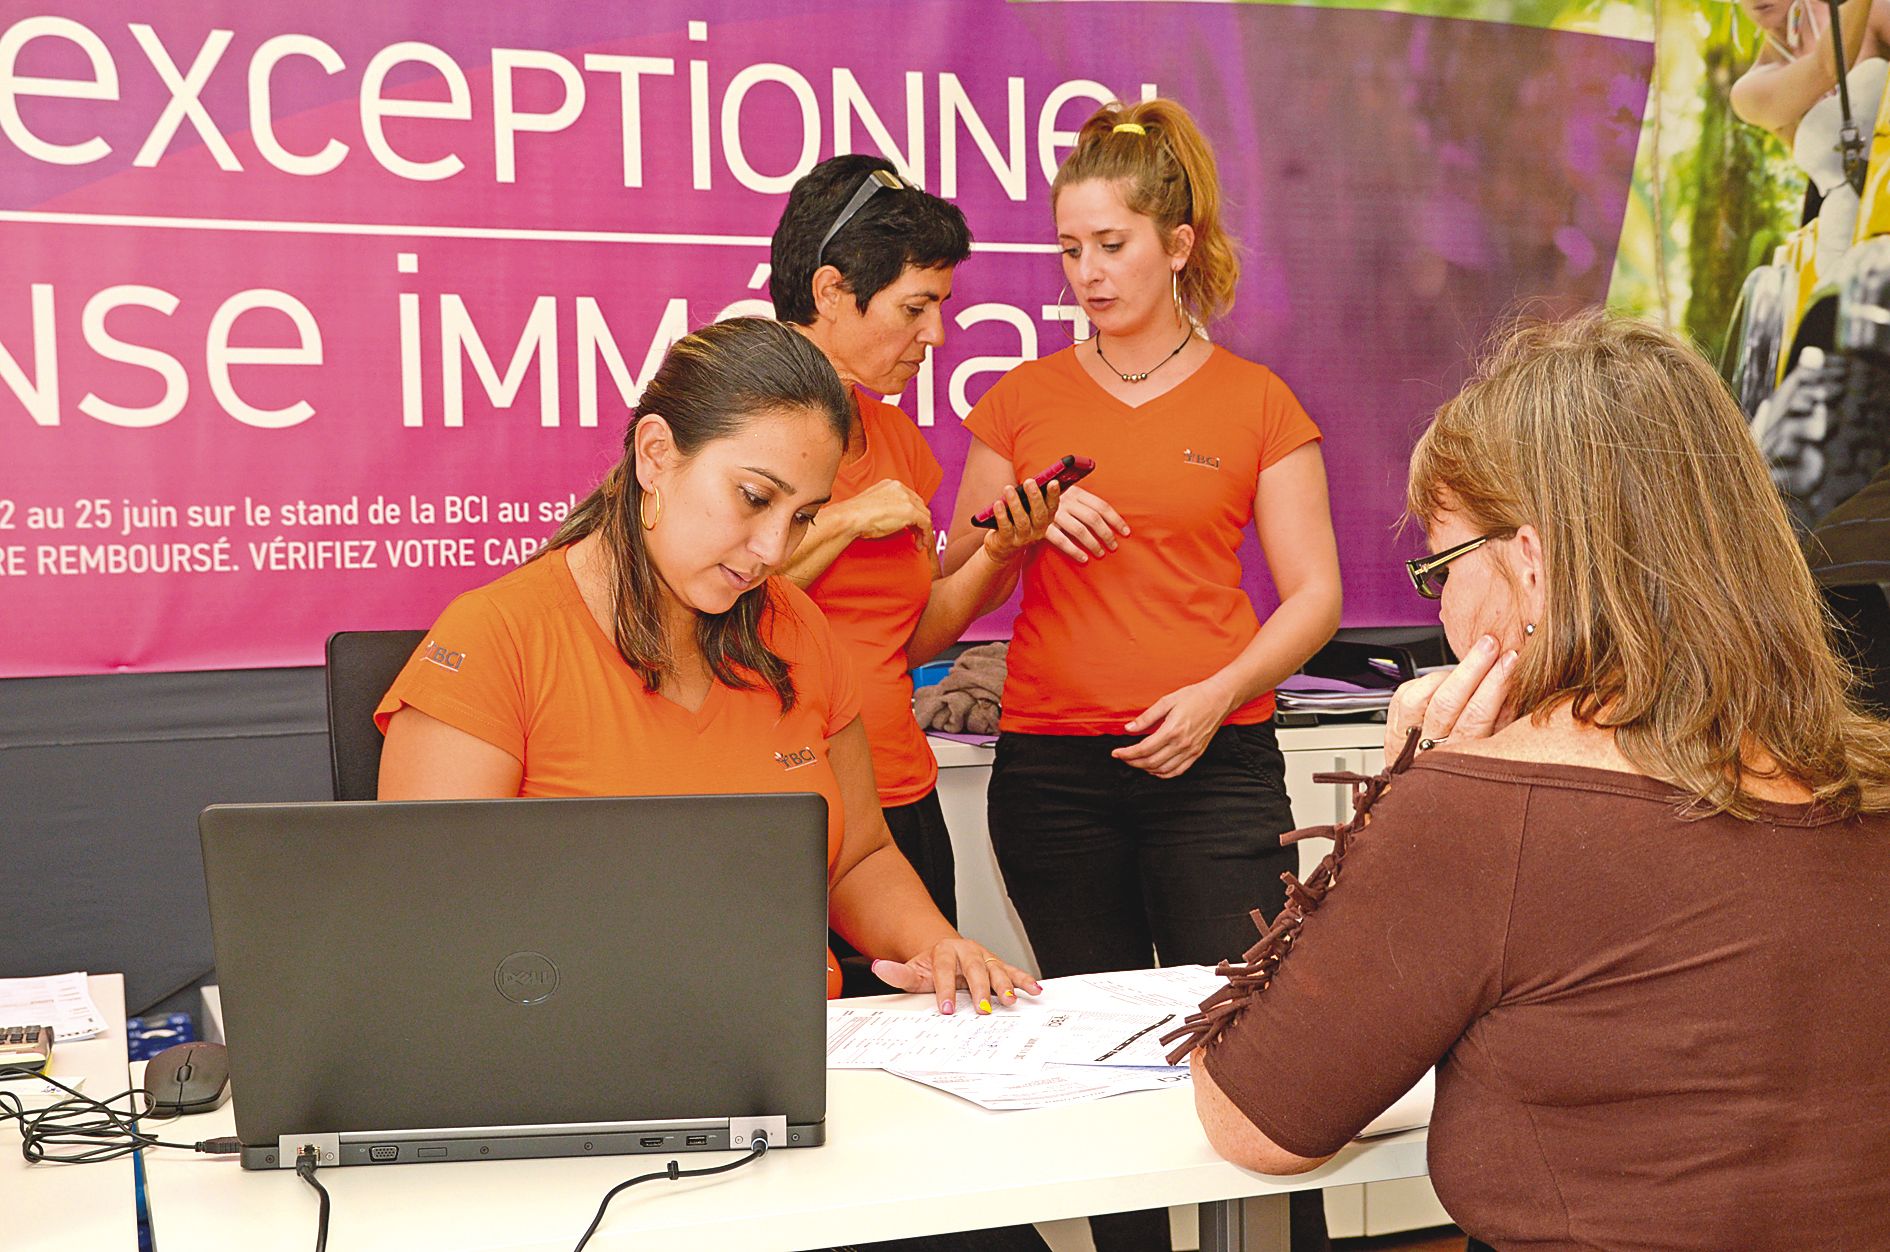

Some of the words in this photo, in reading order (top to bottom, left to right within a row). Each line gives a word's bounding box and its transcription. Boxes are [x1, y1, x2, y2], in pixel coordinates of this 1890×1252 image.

[0, 15, 1157, 201] excePTiONNe
[27, 506, 64, 529] au
[75, 499, 112, 528] 25
[121, 499, 178, 535] juin
[187, 505, 236, 527] sur
[245, 496, 271, 526] le
[280, 495, 359, 525] stand
[368, 495, 401, 525] de
[410, 495, 436, 524] la
[445, 495, 488, 523] BCI
[498, 502, 529, 523] au
[538, 493, 576, 522] sal
[37, 536, 240, 575] REMBOURSÉ.
[248, 535, 377, 571] VÉRIFIEZ
[385, 538, 475, 568] VOTRE
